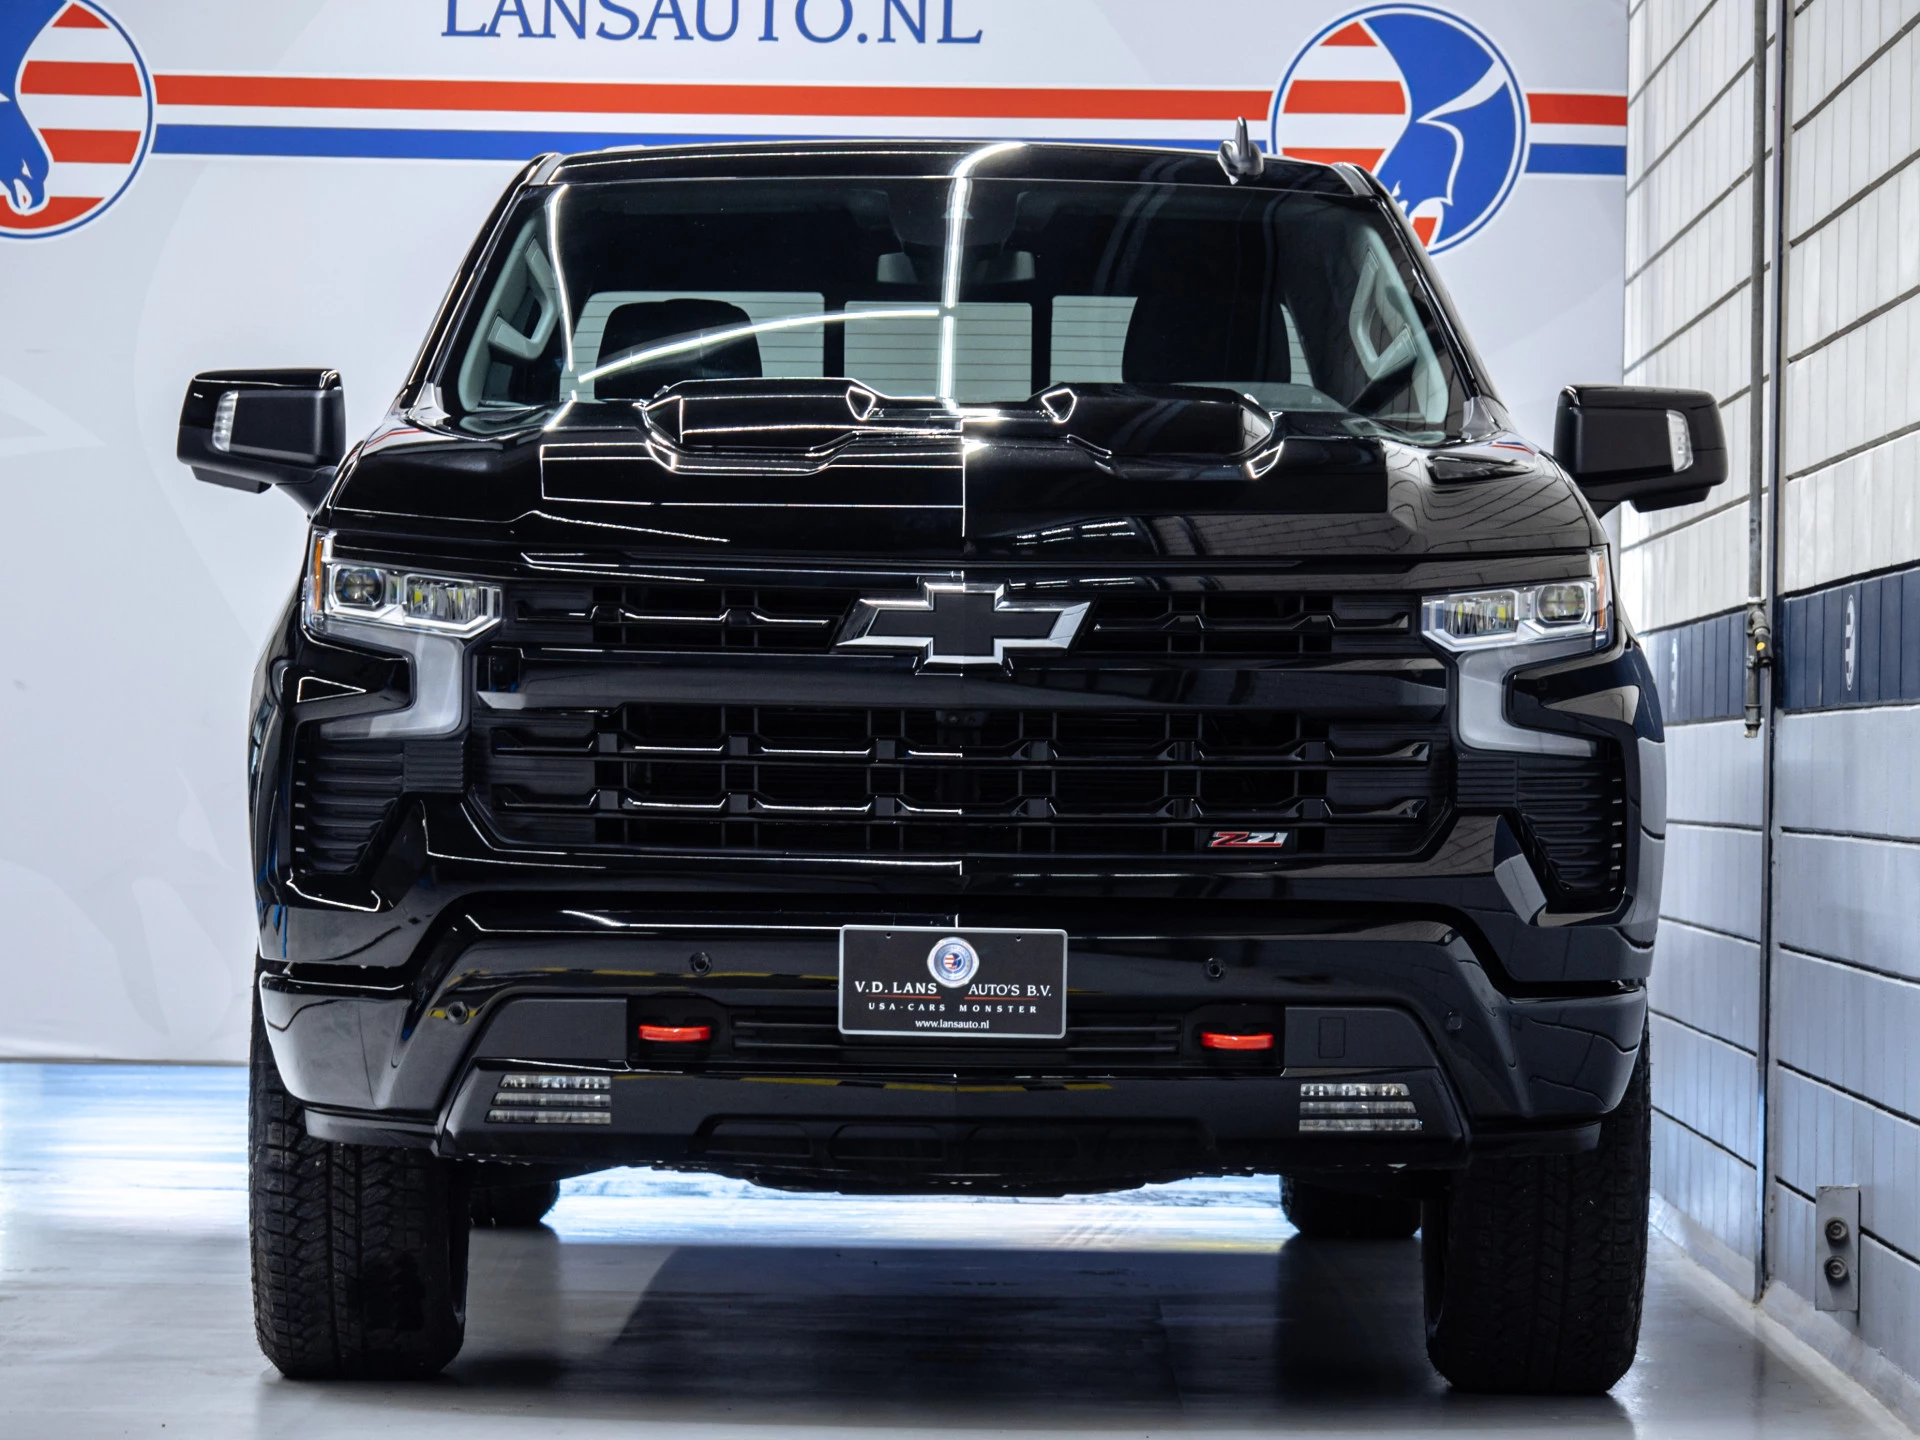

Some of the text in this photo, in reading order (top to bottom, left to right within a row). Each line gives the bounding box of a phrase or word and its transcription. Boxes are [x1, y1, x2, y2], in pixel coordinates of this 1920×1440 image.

[441, 0, 984, 44] LANSAUTO.NL
[1208, 831, 1288, 848] Z71
[854, 981, 1052, 997] V.D. LANS AUTO'S B.V.
[868, 1002, 1037, 1014] USA-CARS MONSTER
[915, 1018, 990, 1030] www.lansauto.nl
